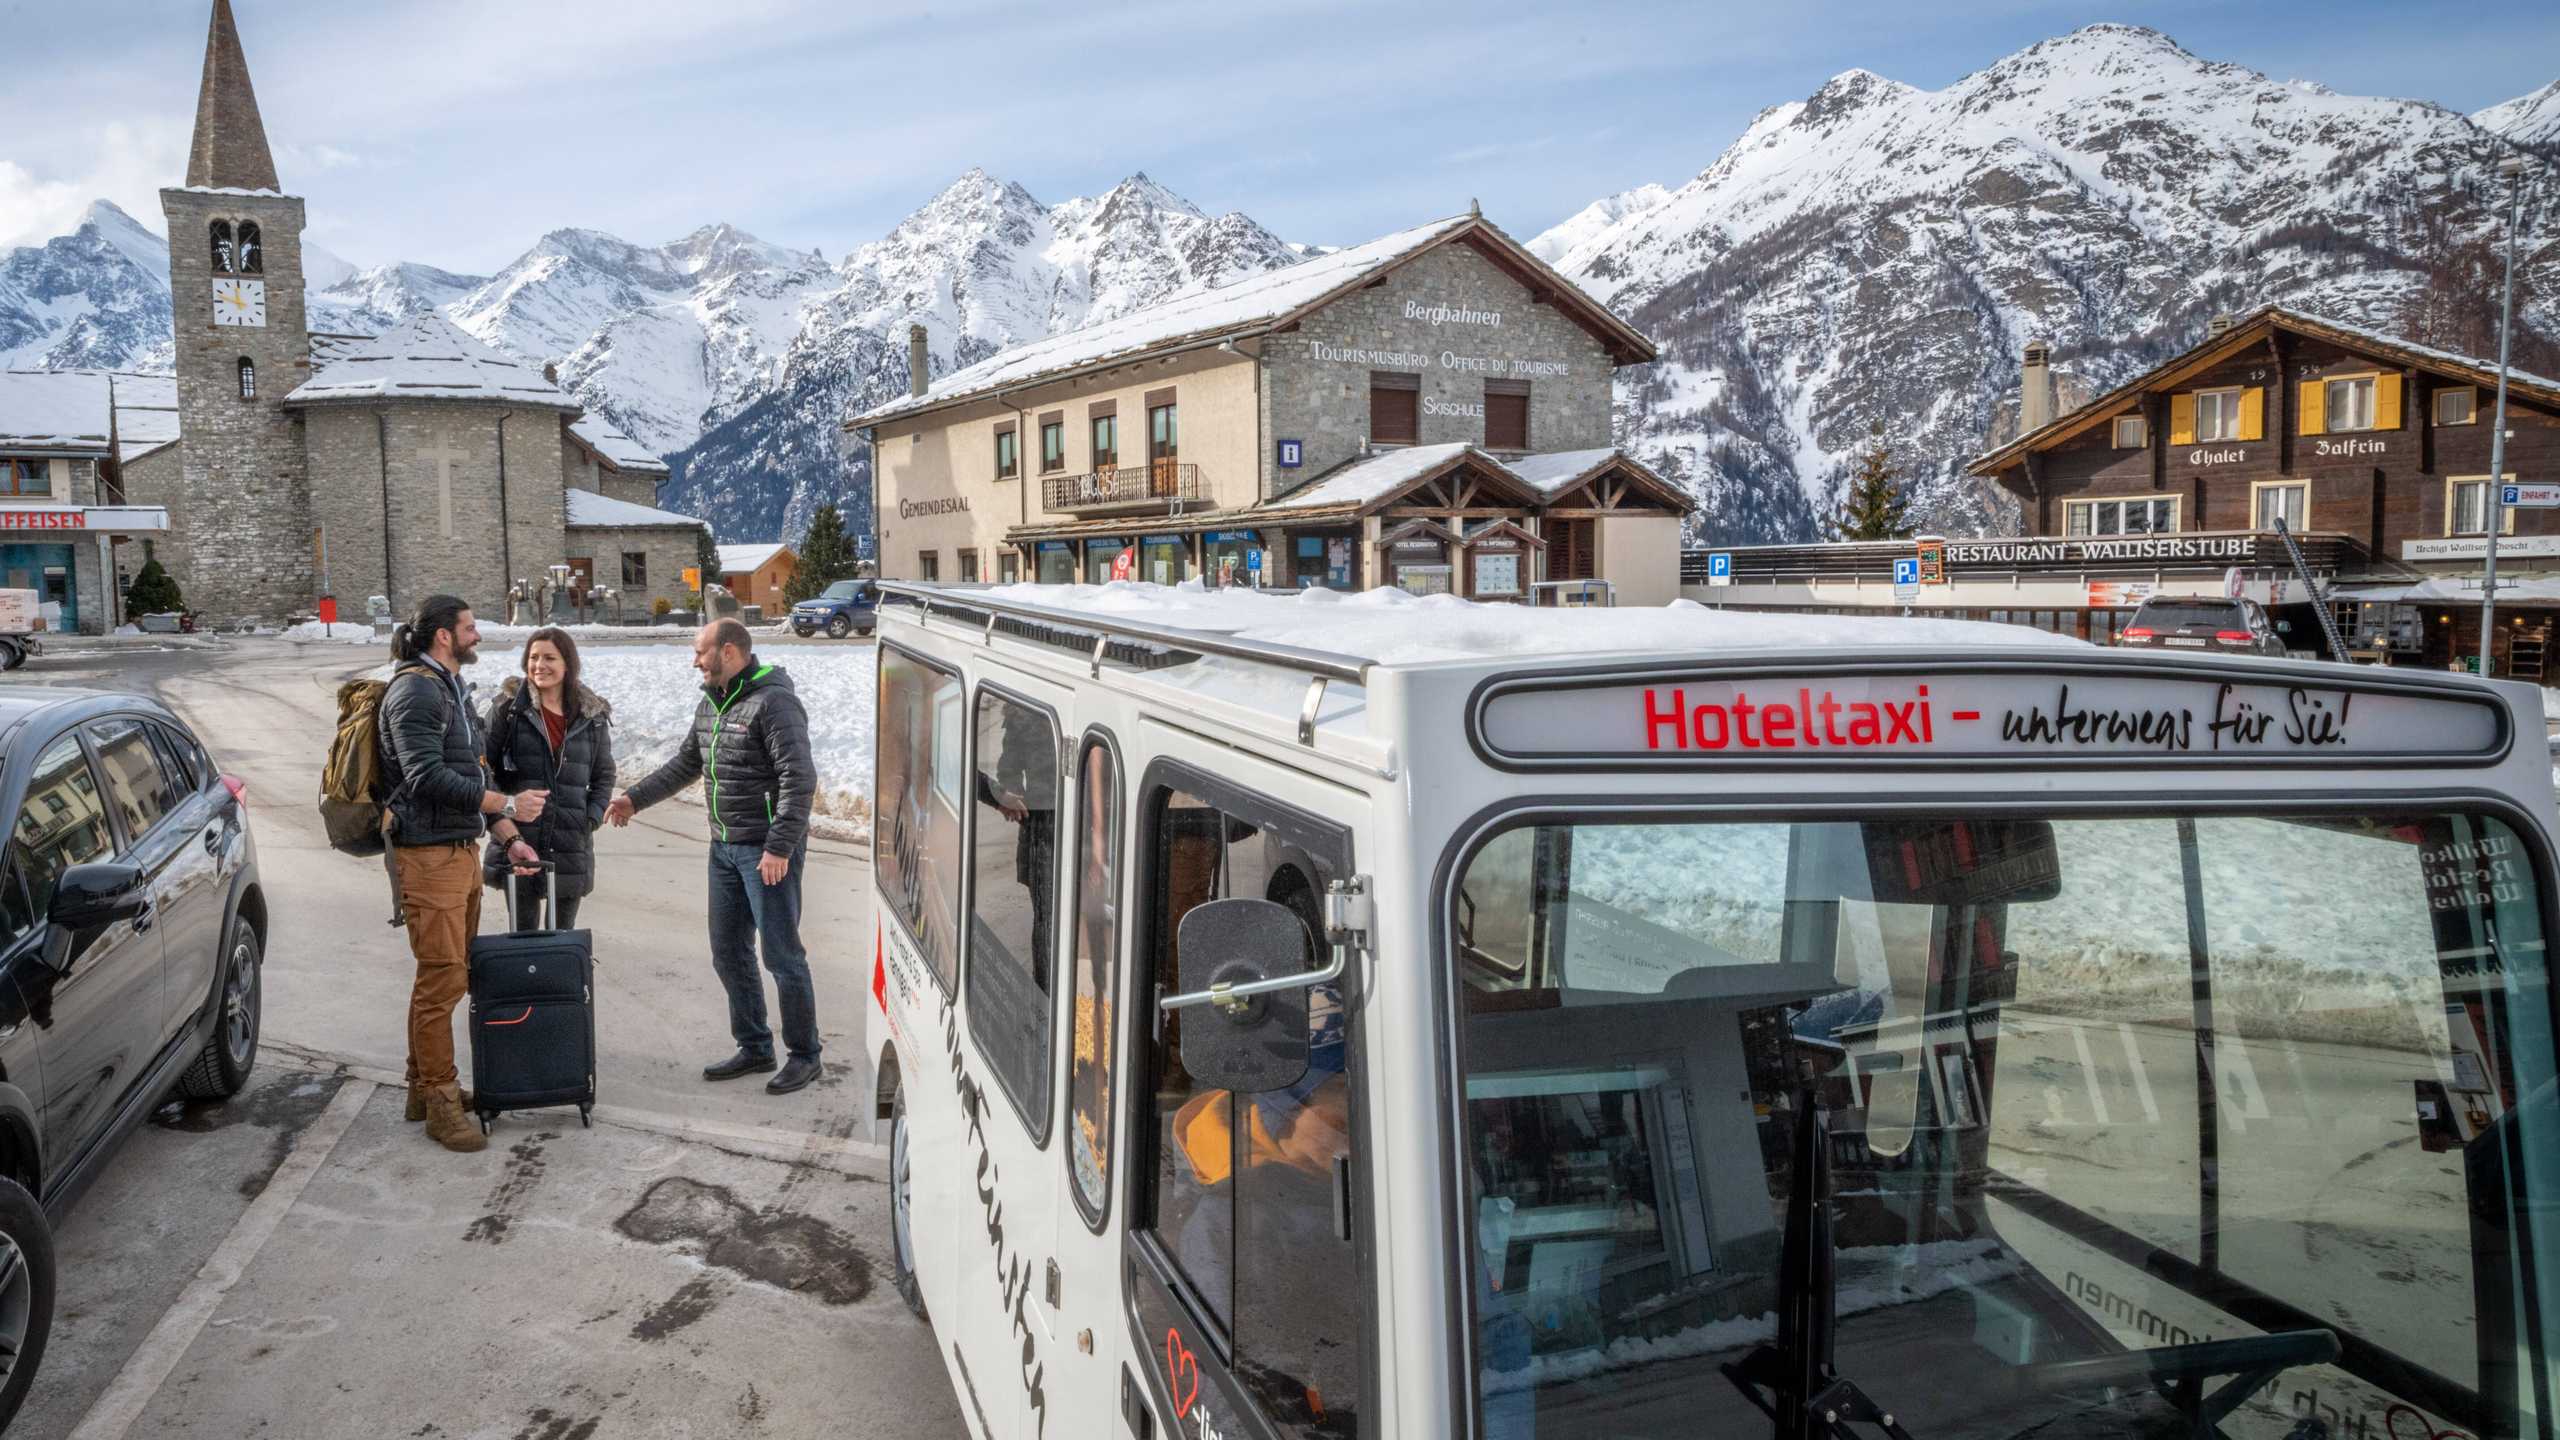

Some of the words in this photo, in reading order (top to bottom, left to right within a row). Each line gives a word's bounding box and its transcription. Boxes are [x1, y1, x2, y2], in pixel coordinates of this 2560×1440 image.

[1404, 300, 1502, 328] Bergbahnen
[1310, 340, 1429, 369] TOURISMUSBÜRO
[1441, 350, 1487, 371] OFFICE
[1492, 358, 1509, 371] DU
[1513, 359, 1569, 376] TOURISME
[1423, 397, 1485, 417] SKISCHULE
[2189, 447, 2246, 468] Chalet
[2314, 438, 2387, 457] Balfrin
[899, 495, 971, 520] GEMEINDESAAL
[2520, 491, 2551, 501] EINFAHRT
[0, 512, 86, 529] FFEISEN
[1946, 544, 2069, 563] RESTAURANT
[2081, 539, 2256, 562] WALLISERSTUBE
[1715, 558, 1726, 575] P
[1896, 562, 1909, 583] P
[1643, 684, 1934, 752] Hoteltaxi
[2000, 683, 2194, 752] unterwegs
[2205, 683, 2275, 752] für
[2284, 686, 2353, 748] Sie!
